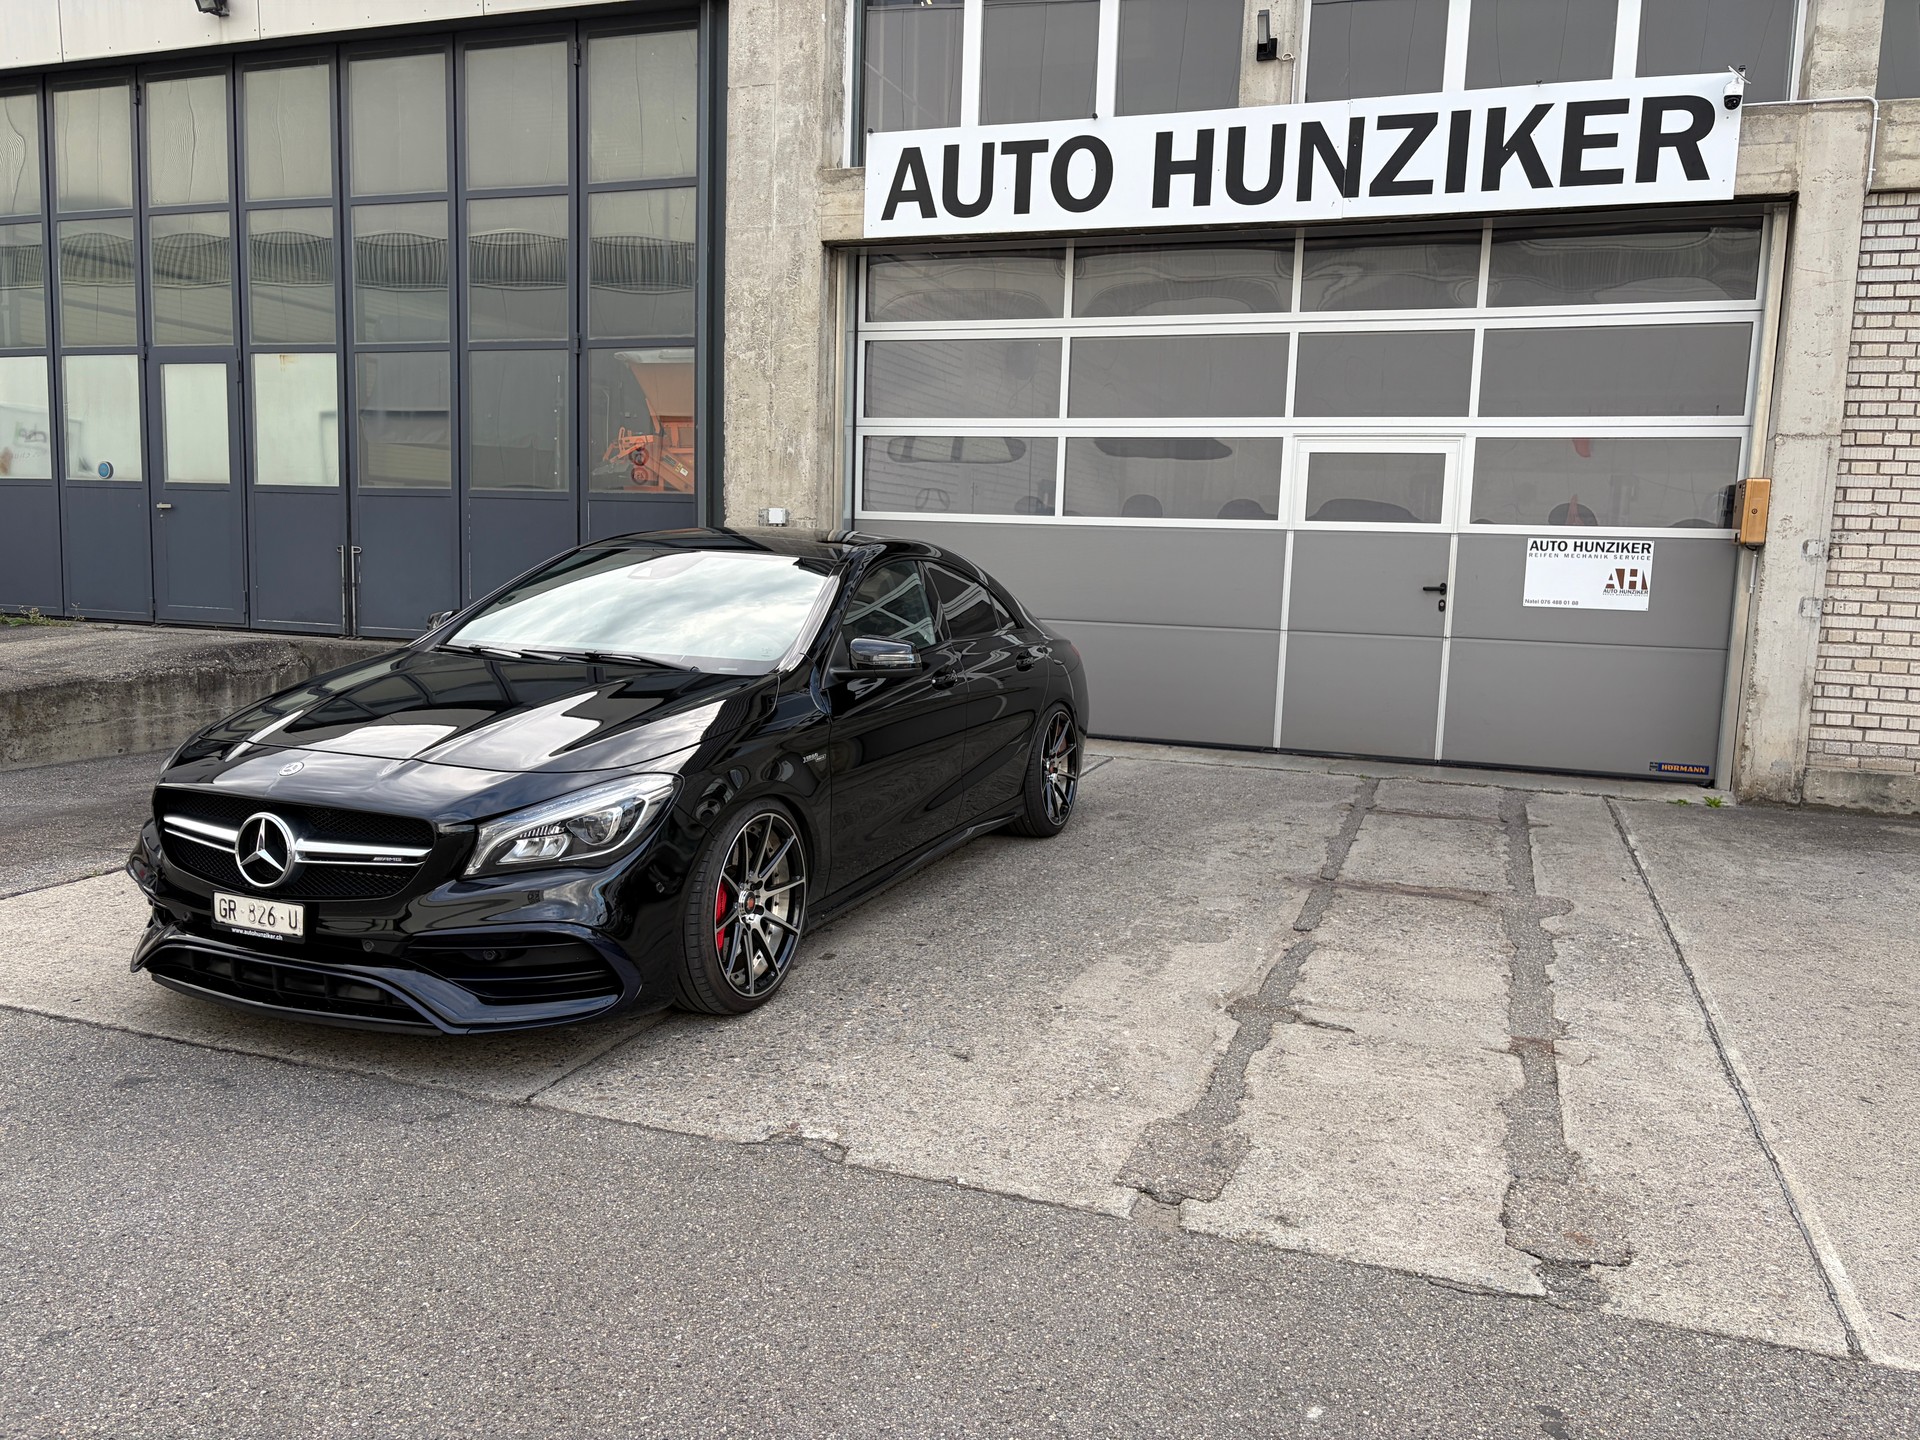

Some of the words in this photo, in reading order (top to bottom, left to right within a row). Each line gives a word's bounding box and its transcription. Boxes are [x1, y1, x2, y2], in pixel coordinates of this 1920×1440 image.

[880, 134, 1114, 221] AUTO
[1151, 94, 1716, 209] HUNZIKER
[1530, 540, 1568, 551] AUTO
[1573, 541, 1652, 554] HUNZIKER
[219, 898, 238, 921] GR
[248, 902, 276, 927] 826
[288, 909, 298, 930] U
[231, 927, 283, 940] www.autohunziker.ch
